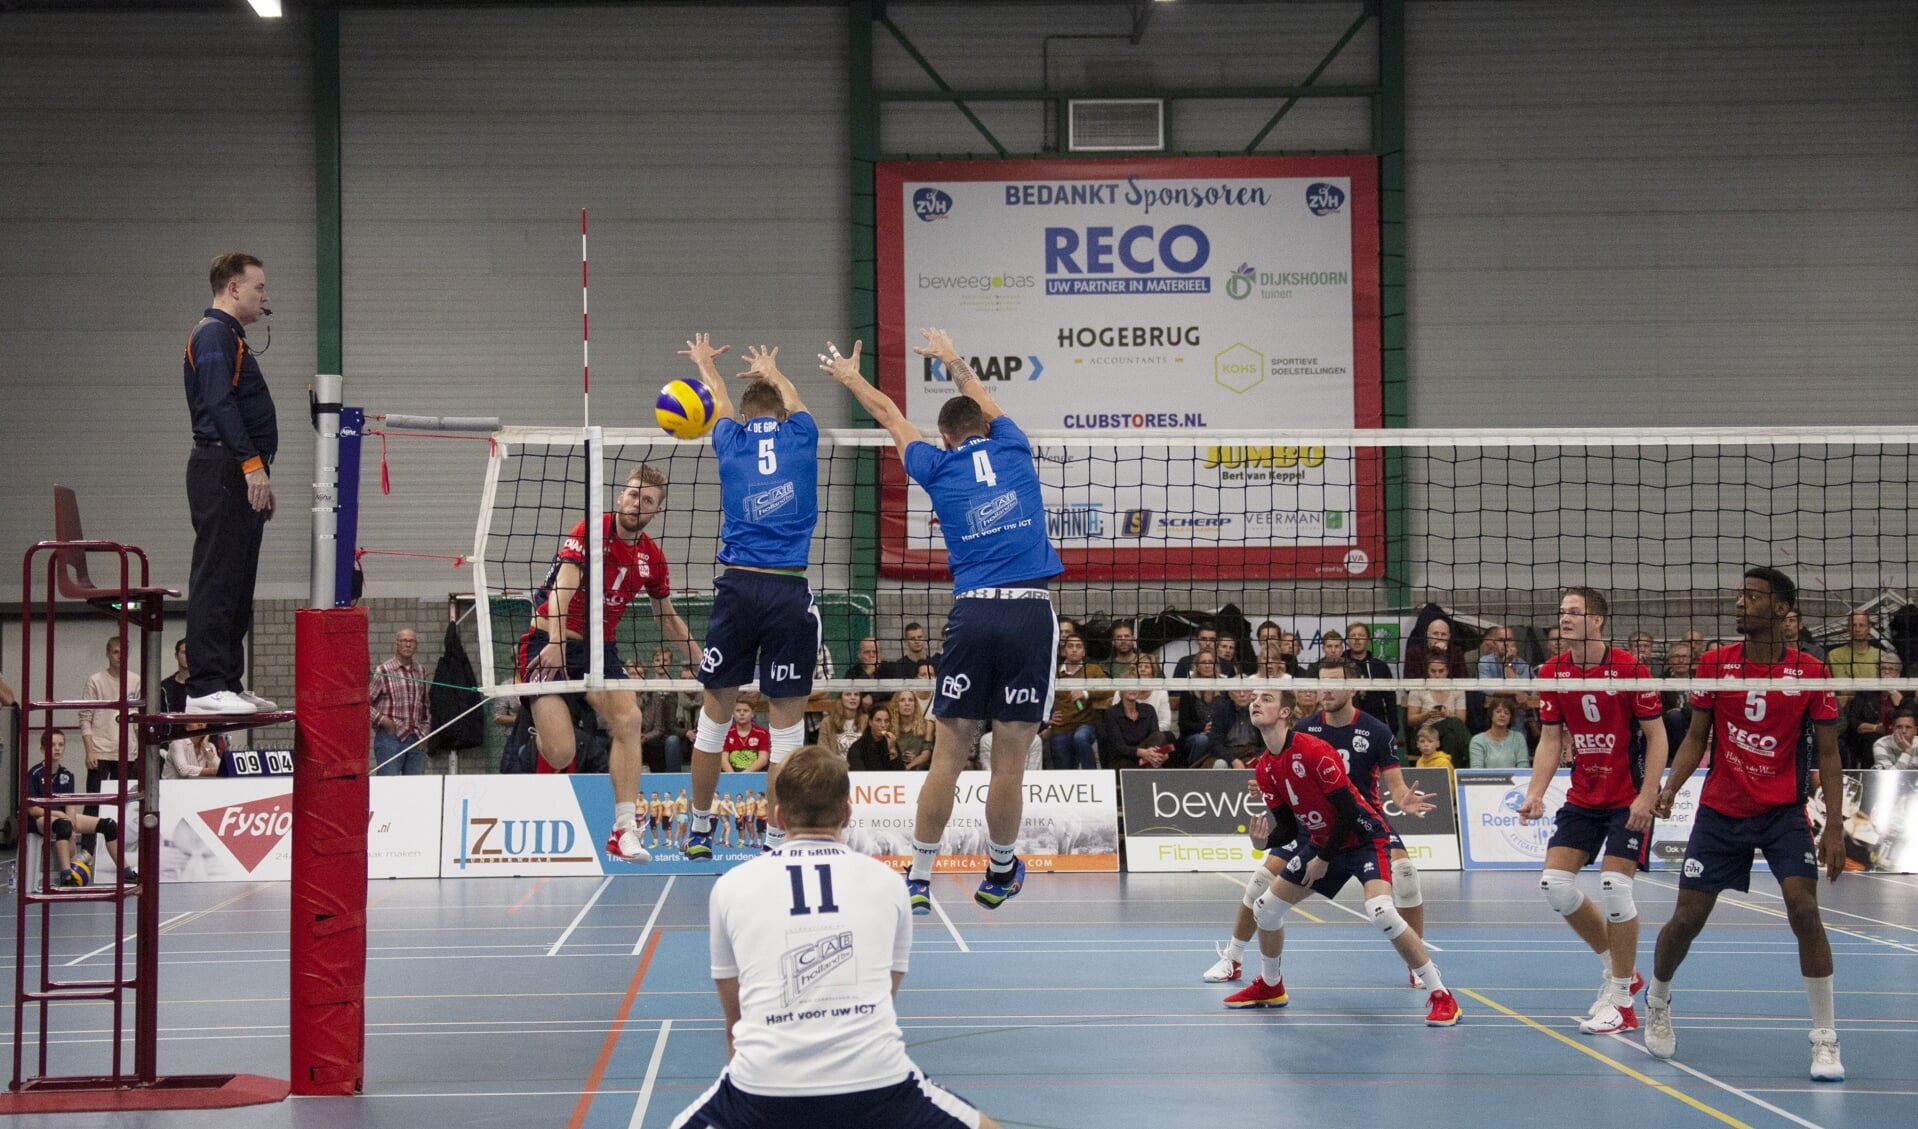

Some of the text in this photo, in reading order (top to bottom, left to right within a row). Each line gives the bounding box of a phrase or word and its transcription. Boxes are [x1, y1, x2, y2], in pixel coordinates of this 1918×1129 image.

[1005, 175, 1272, 214] BEDANKT Sponsoren
[1309, 194, 1339, 208] ZVH
[916, 200, 947, 214] ZVH
[1045, 224, 1210, 274] RECO
[1049, 279, 1208, 292] UW PARTNER IN MATERIEEL
[1260, 271, 1348, 286] DIJKSHOORN
[1261, 289, 1292, 299] tuinen
[1057, 327, 1200, 348] HOGEBRUG
[1089, 356, 1167, 365] ACCOUNTANTS
[1271, 358, 1318, 366] SPORTIEVE
[1222, 364, 1257, 374] KOHS
[1271, 367, 1346, 376] DOELSTELLINGEN
[1063, 413, 1207, 429] CLUBSTORES.NL
[758, 437, 777, 475] 5
[1204, 445, 1325, 469] JUMBO
[972, 449, 997, 487] 4
[1222, 470, 1306, 482] Bert van Keppel
[1158, 518, 1232, 527] SCHERP
[1246, 512, 1321, 525] VEERMAN
[981, 527, 1002, 536] voor
[1018, 518, 1032, 528] ICT
[611, 566, 628, 591] 1
[1783, 667, 1804, 676] RECO
[1005, 686, 1040, 705] VDL
[1581, 694, 1601, 723] 6
[1744, 690, 1767, 722] 5
[1354, 728, 1371, 737] RECO
[1574, 733, 1616, 749] RECO
[236, 755, 260, 773] 09
[268, 755, 292, 772] 04
[848, 785, 906, 805] NGE
[1672, 800, 1693, 810] nch
[217, 805, 293, 837] Fysio
[872, 818, 914, 828] MOOIS
[1025, 817, 1055, 827] RIKA
[470, 818, 576, 855] ZUID
[1158, 843, 1243, 861] Fitness
[1665, 845, 1679, 853] Ook
[655, 854, 680, 862] starts
[726, 853, 757, 862] under
[785, 863, 839, 916] 11
[765, 1003, 877, 1026] Hart voor uw ICT
